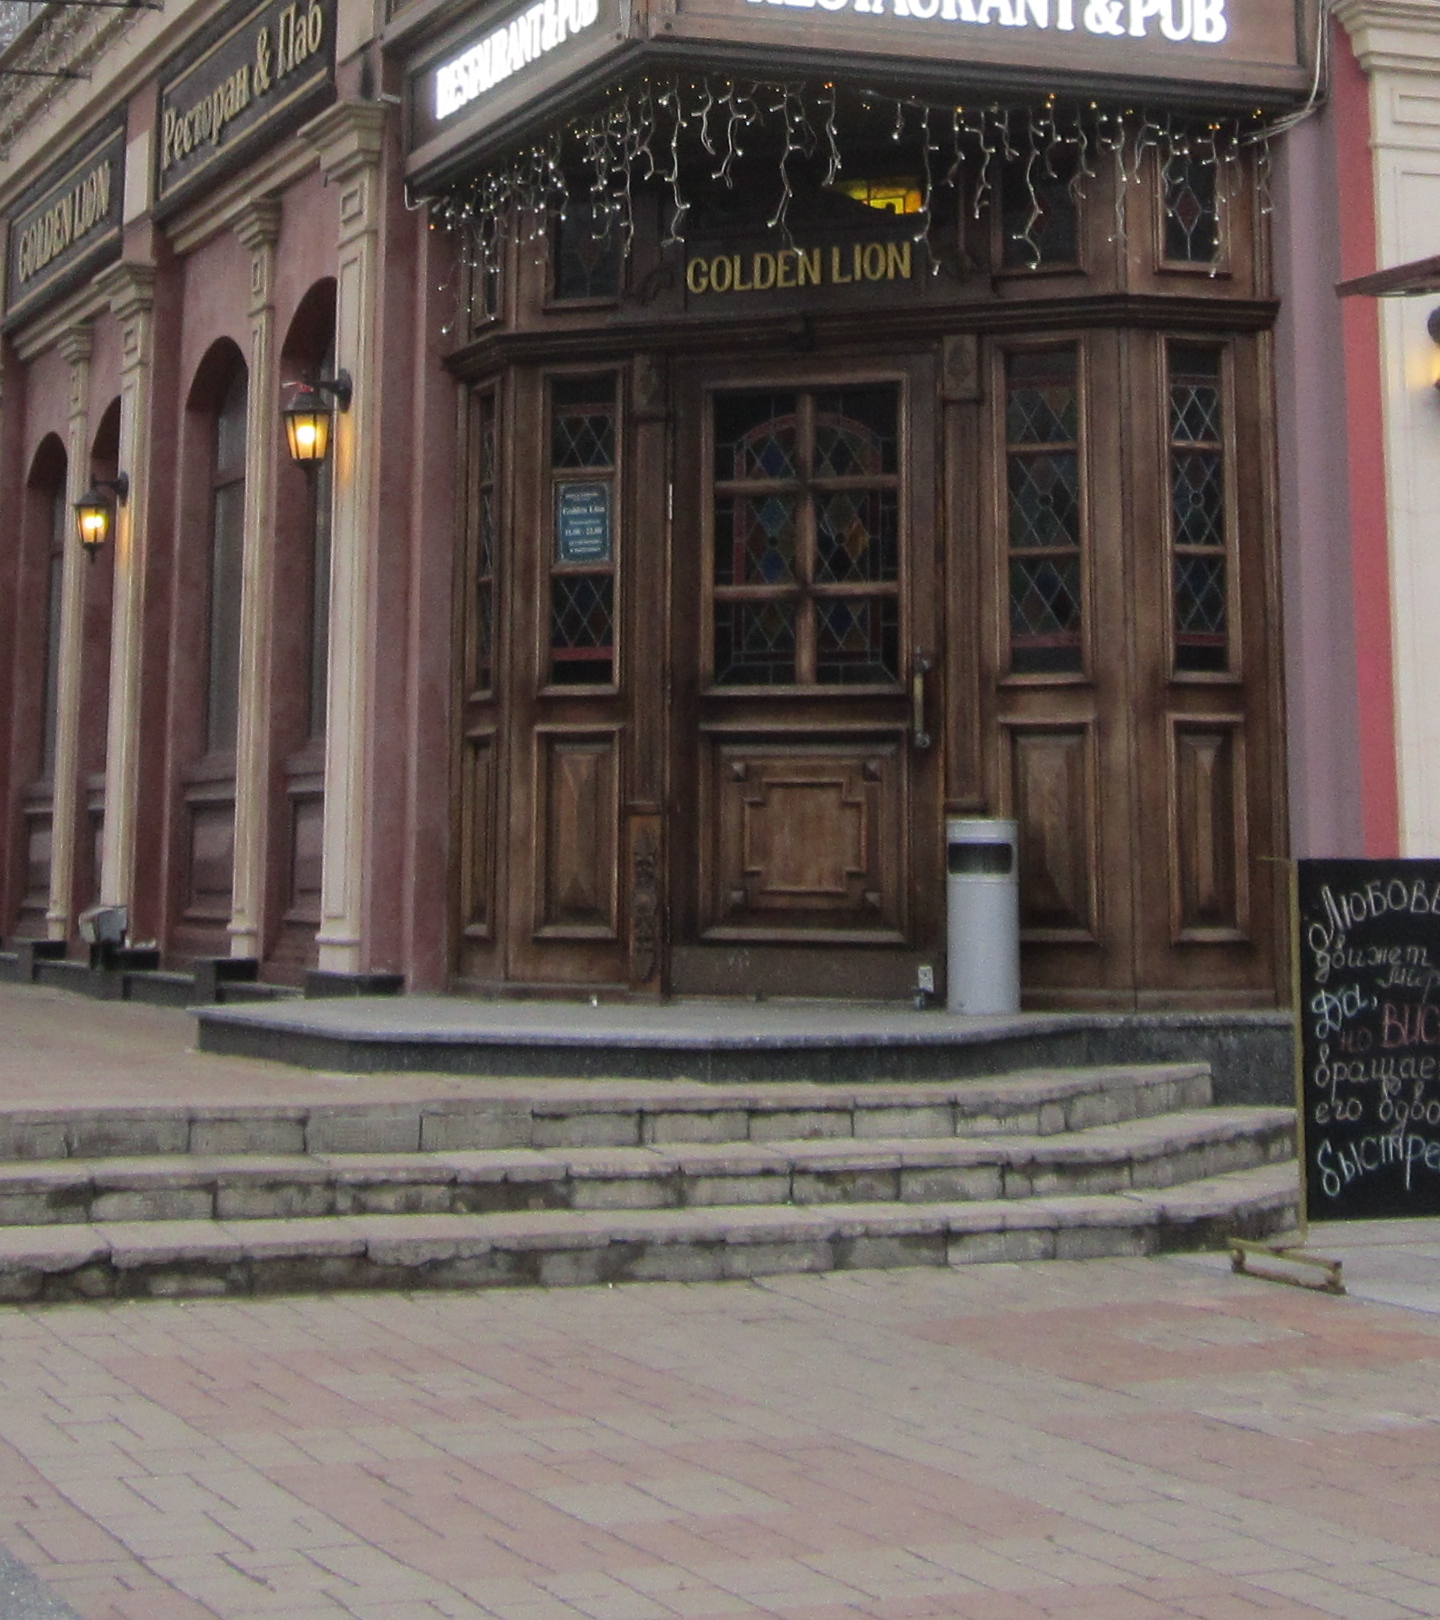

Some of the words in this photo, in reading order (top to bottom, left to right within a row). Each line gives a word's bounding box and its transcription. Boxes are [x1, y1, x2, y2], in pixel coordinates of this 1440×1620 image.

[163, 64, 250, 171] Ресторан
[253, 26, 271, 96] &
[686, 248, 821, 294] GOLDEN
[832, 241, 911, 284] LION
[1315, 1097, 1363, 1126] его
